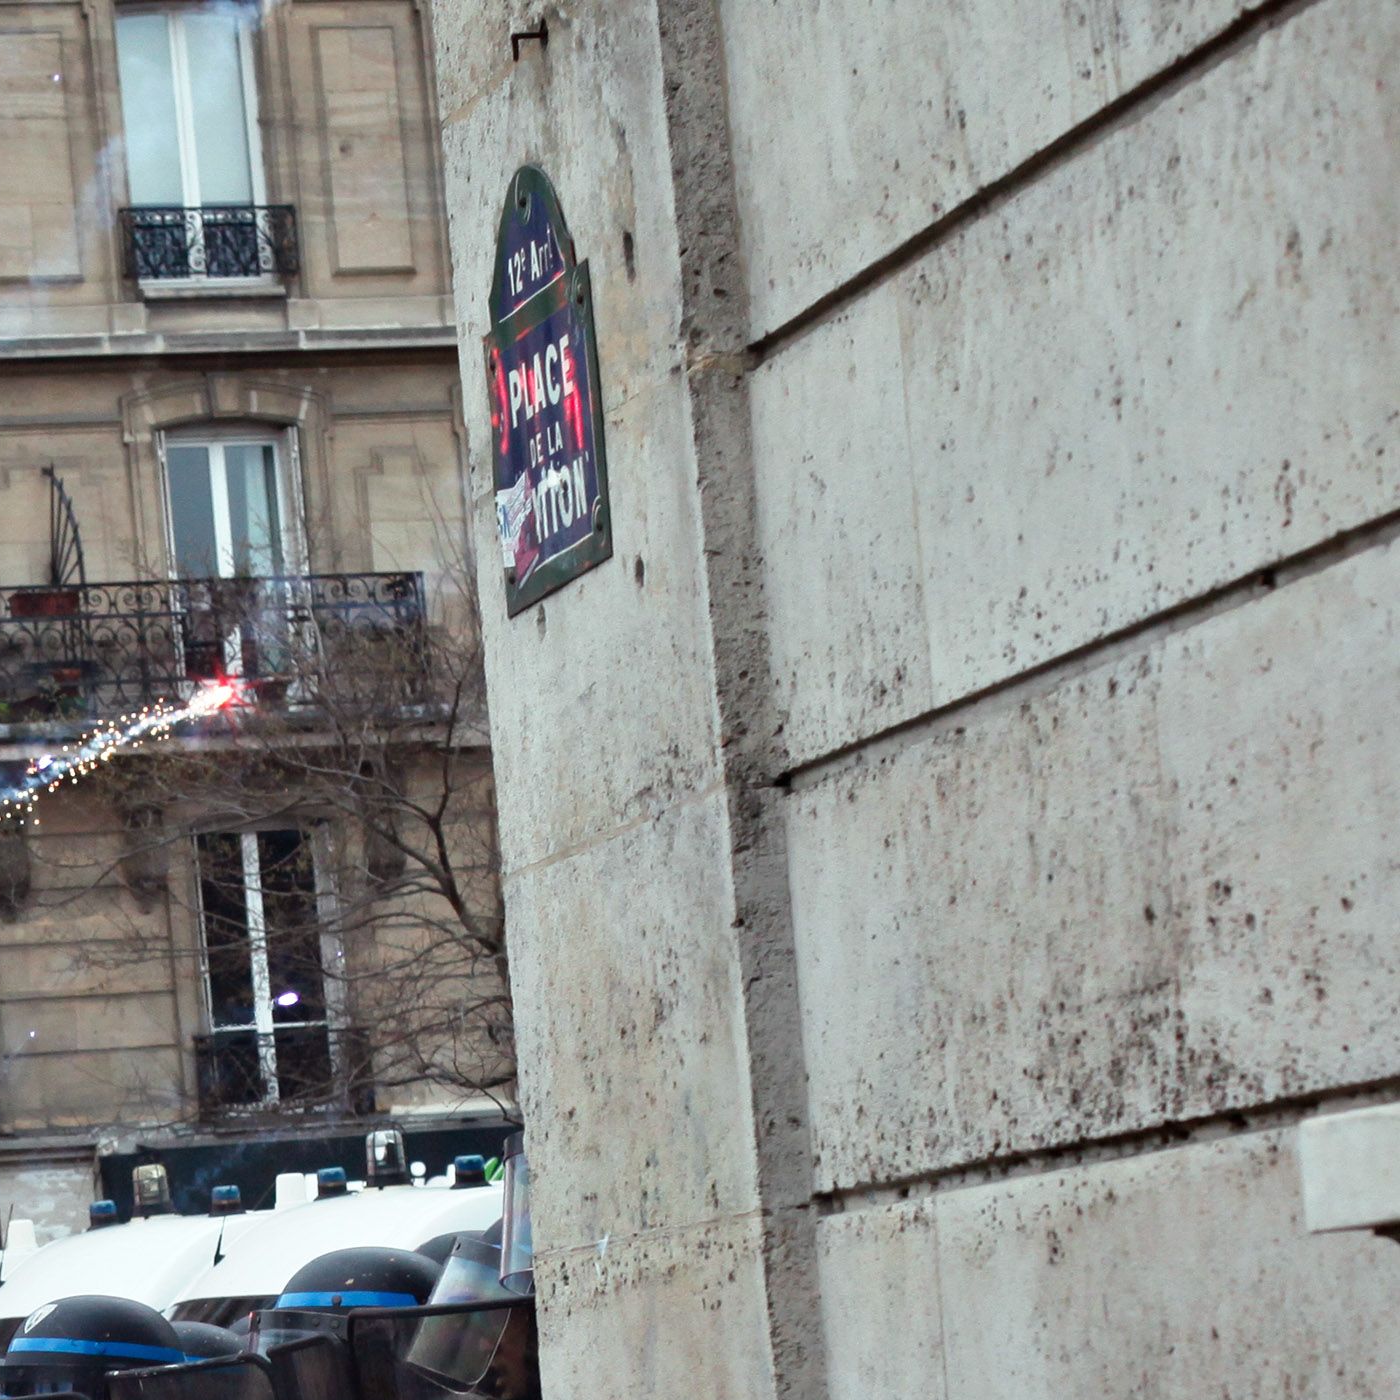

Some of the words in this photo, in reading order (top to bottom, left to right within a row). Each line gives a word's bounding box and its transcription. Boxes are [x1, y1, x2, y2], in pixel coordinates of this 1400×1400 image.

[508, 333, 575, 429] PLACE
[529, 432, 544, 469] DE
[547, 421, 564, 456] LA
